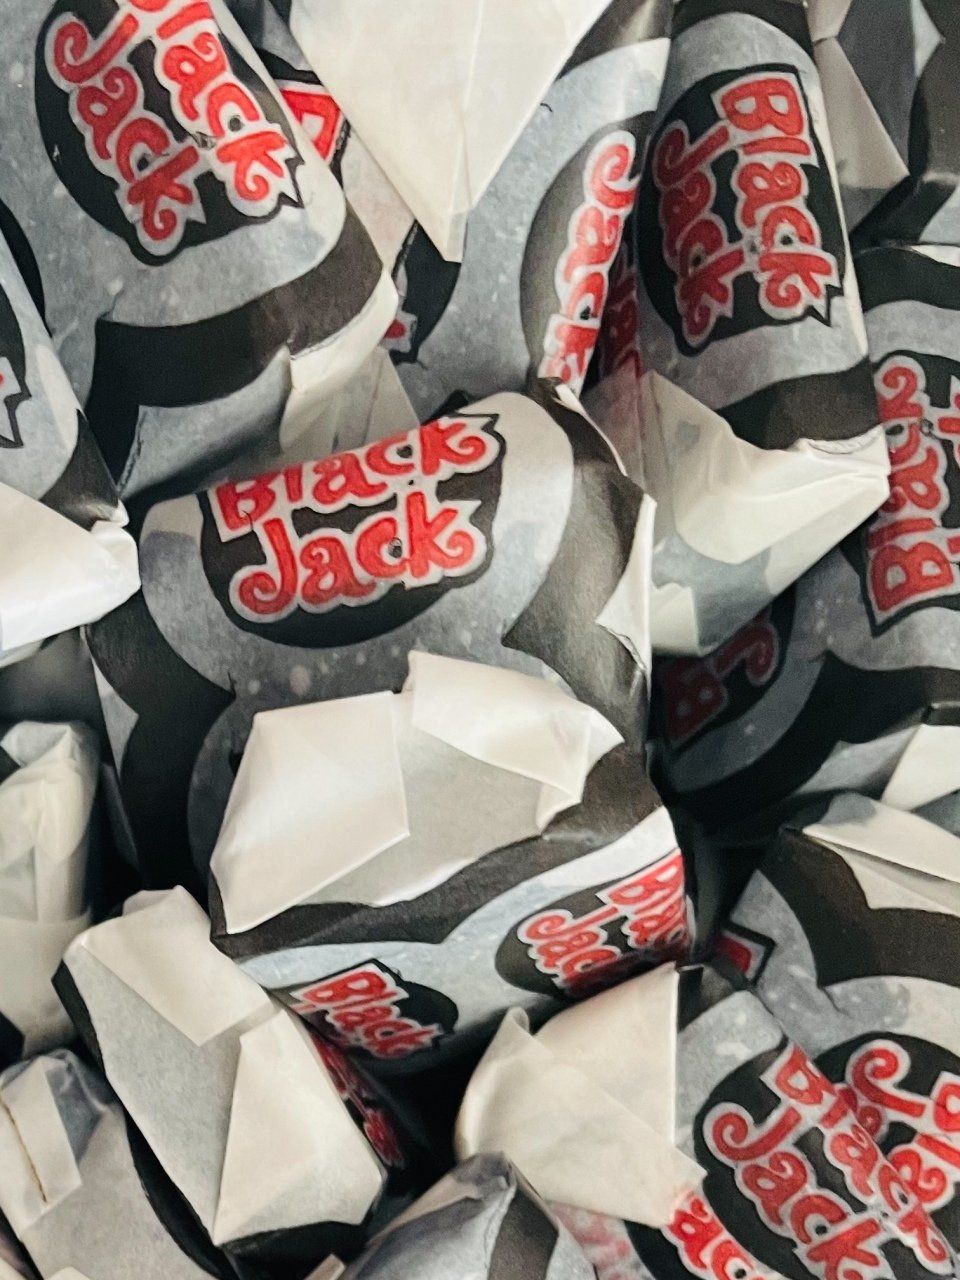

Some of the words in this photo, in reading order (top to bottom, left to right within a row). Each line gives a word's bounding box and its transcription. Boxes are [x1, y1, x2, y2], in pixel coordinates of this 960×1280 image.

[52, 13, 201, 242] Jack
[130, 0, 292, 202] lack
[720, 77, 837, 308] Black
[653, 125, 746, 336] Jack
[239, 490, 475, 615] Jack
